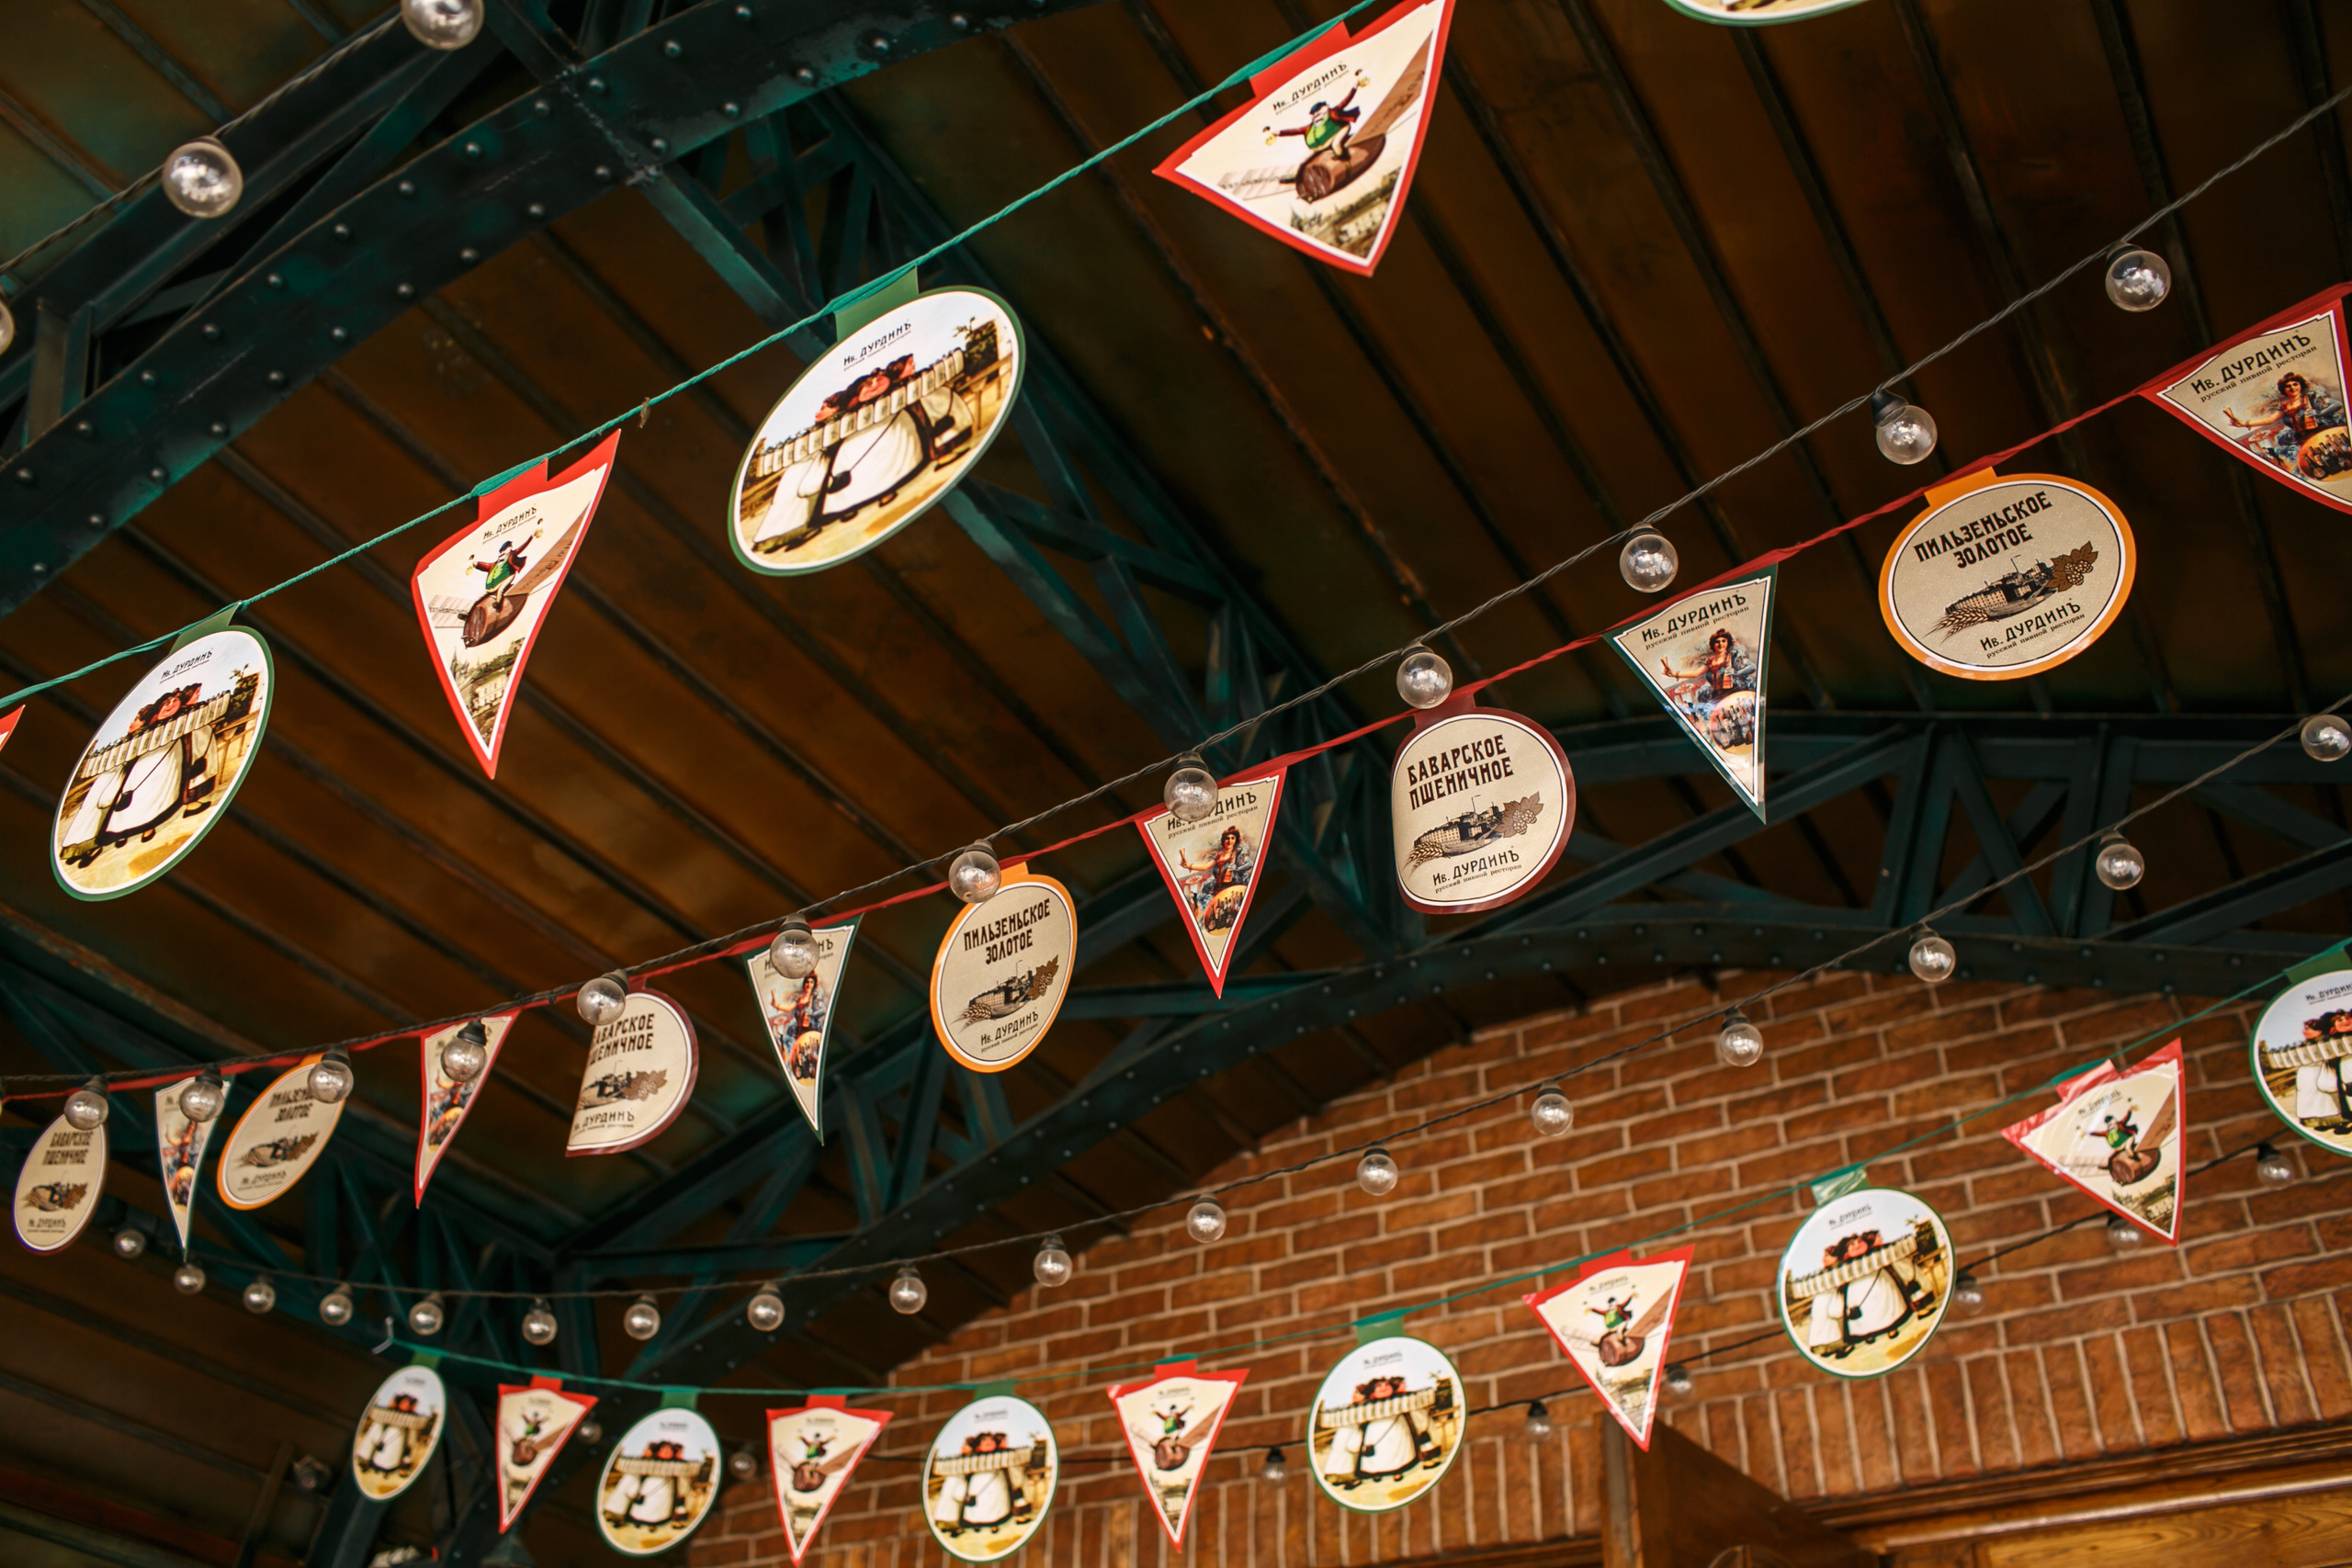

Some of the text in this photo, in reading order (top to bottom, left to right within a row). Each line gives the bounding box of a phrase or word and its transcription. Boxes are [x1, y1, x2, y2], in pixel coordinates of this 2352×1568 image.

[1292, 63, 1347, 101] ДУРДИНЪ
[860, 322, 911, 357] ДУРДИНЪ
[2221, 334, 2311, 383] ДУРДИНЪ
[2200, 345, 2317, 402] русский пивной ресторан
[1913, 491, 2052, 562] ПИЛЬЗЕНЬСКОЕ
[1953, 523, 2033, 569] ЗОЛОТОЕ
[1668, 594, 1747, 633] ДУРДИНЪ
[1713, 606, 1749, 624] ресторан
[2006, 603, 2080, 642] ДУРДИНЪ
[1986, 641, 2018, 659] русский
[2050, 614, 2086, 632] ресторан
[1407, 734, 1507, 786] БАВАРСКОЕ
[1408, 756, 1514, 810] ПШЕНИЧНОЕ
[1453, 850, 1520, 879] ДУРДИНЪ
[964, 898, 1050, 951] ПИЛЬЗЕНЬСКОЕ
[986, 928, 1033, 964] ЗОЛОТОЕ
[2319, 983, 2352, 998] ДУРДИН
[995, 1011, 1038, 1040] ДУРДИНЪ
